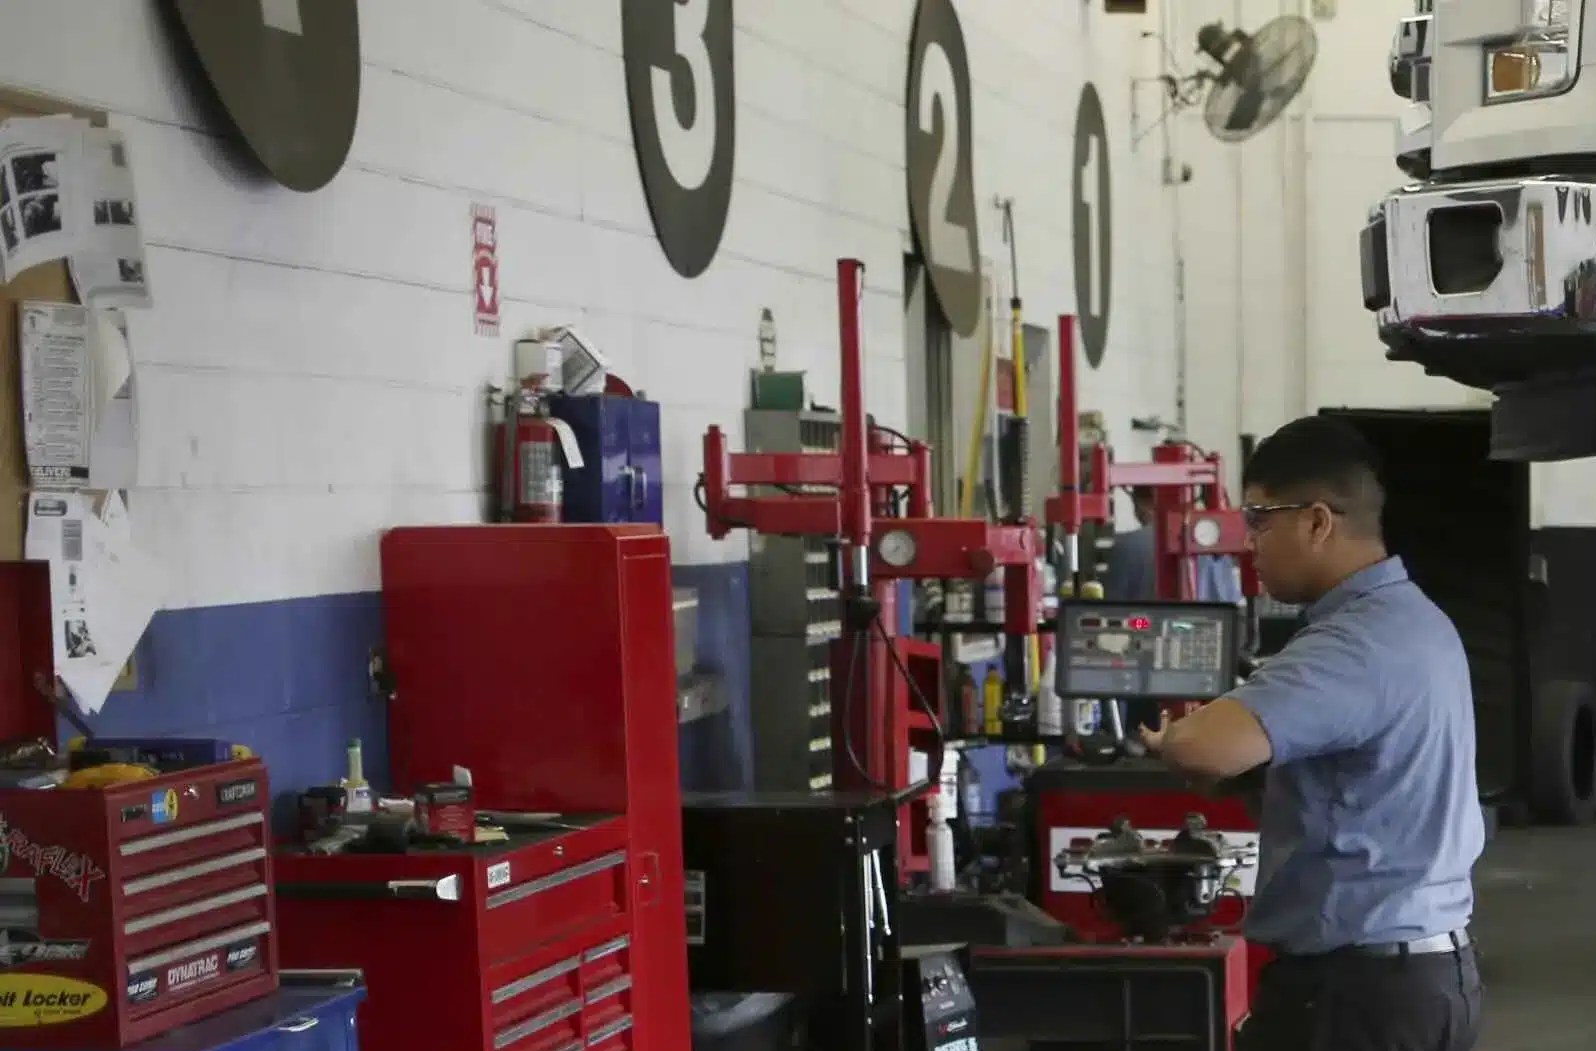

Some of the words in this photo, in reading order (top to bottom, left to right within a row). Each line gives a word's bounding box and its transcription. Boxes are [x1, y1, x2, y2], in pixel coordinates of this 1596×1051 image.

[650, 0, 716, 191] 3
[918, 41, 974, 273] 2
[1081, 134, 1100, 318] 1
[22, 989, 92, 1007] Locker
[167, 954, 219, 986] DYNATRAC
